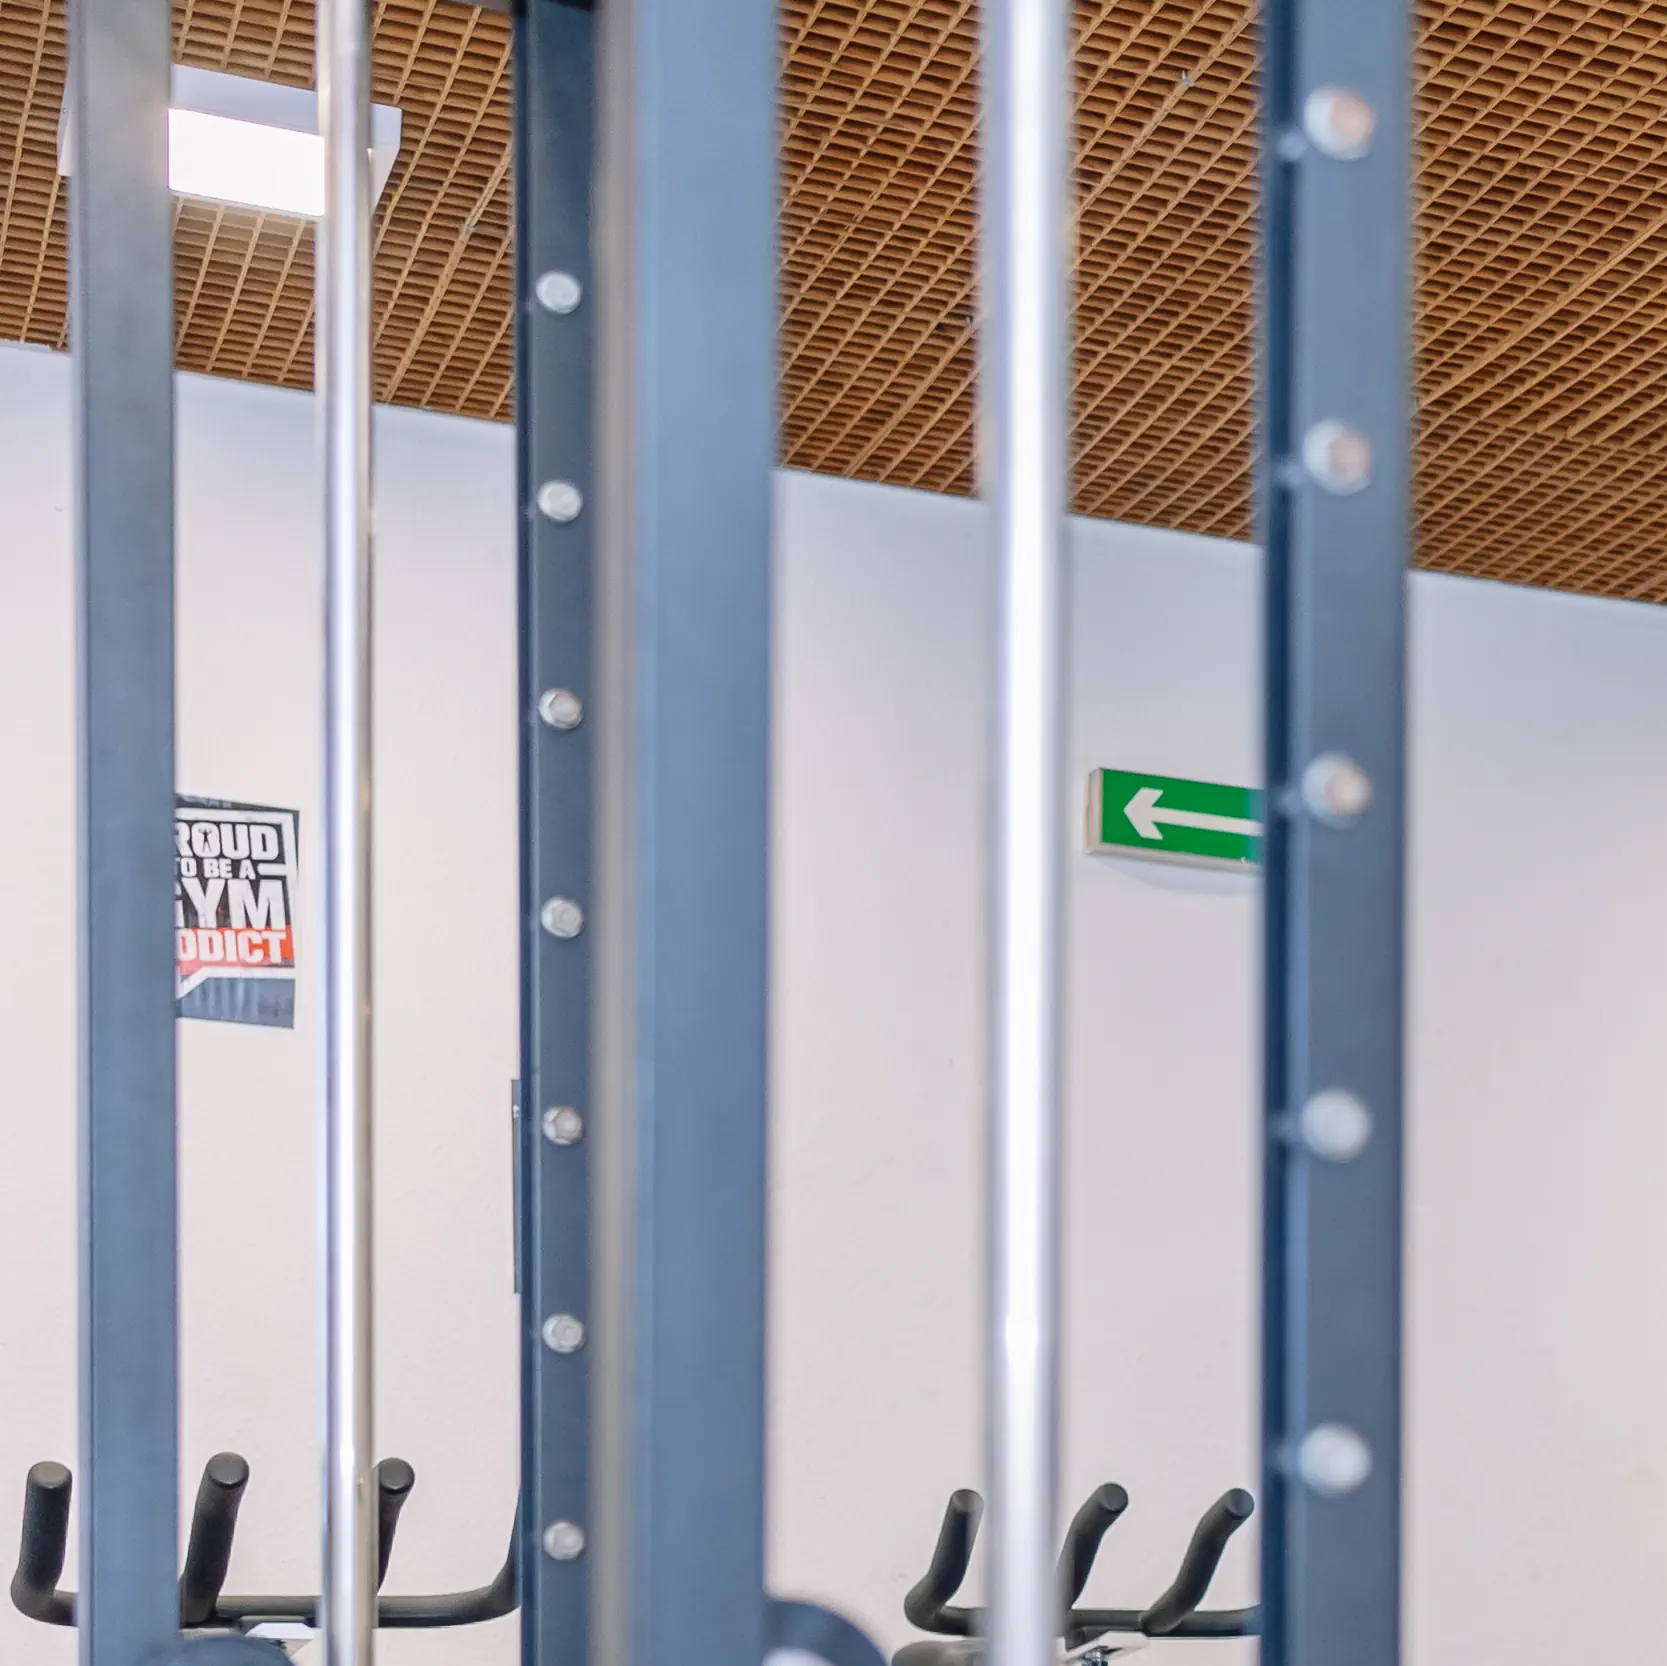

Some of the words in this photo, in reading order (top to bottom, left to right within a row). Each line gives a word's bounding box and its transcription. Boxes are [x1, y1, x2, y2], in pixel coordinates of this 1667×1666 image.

[174, 821, 280, 860] ROUD
[203, 858, 233, 879] BE
[238, 859, 257, 880] A
[175, 928, 288, 964] DDICT
